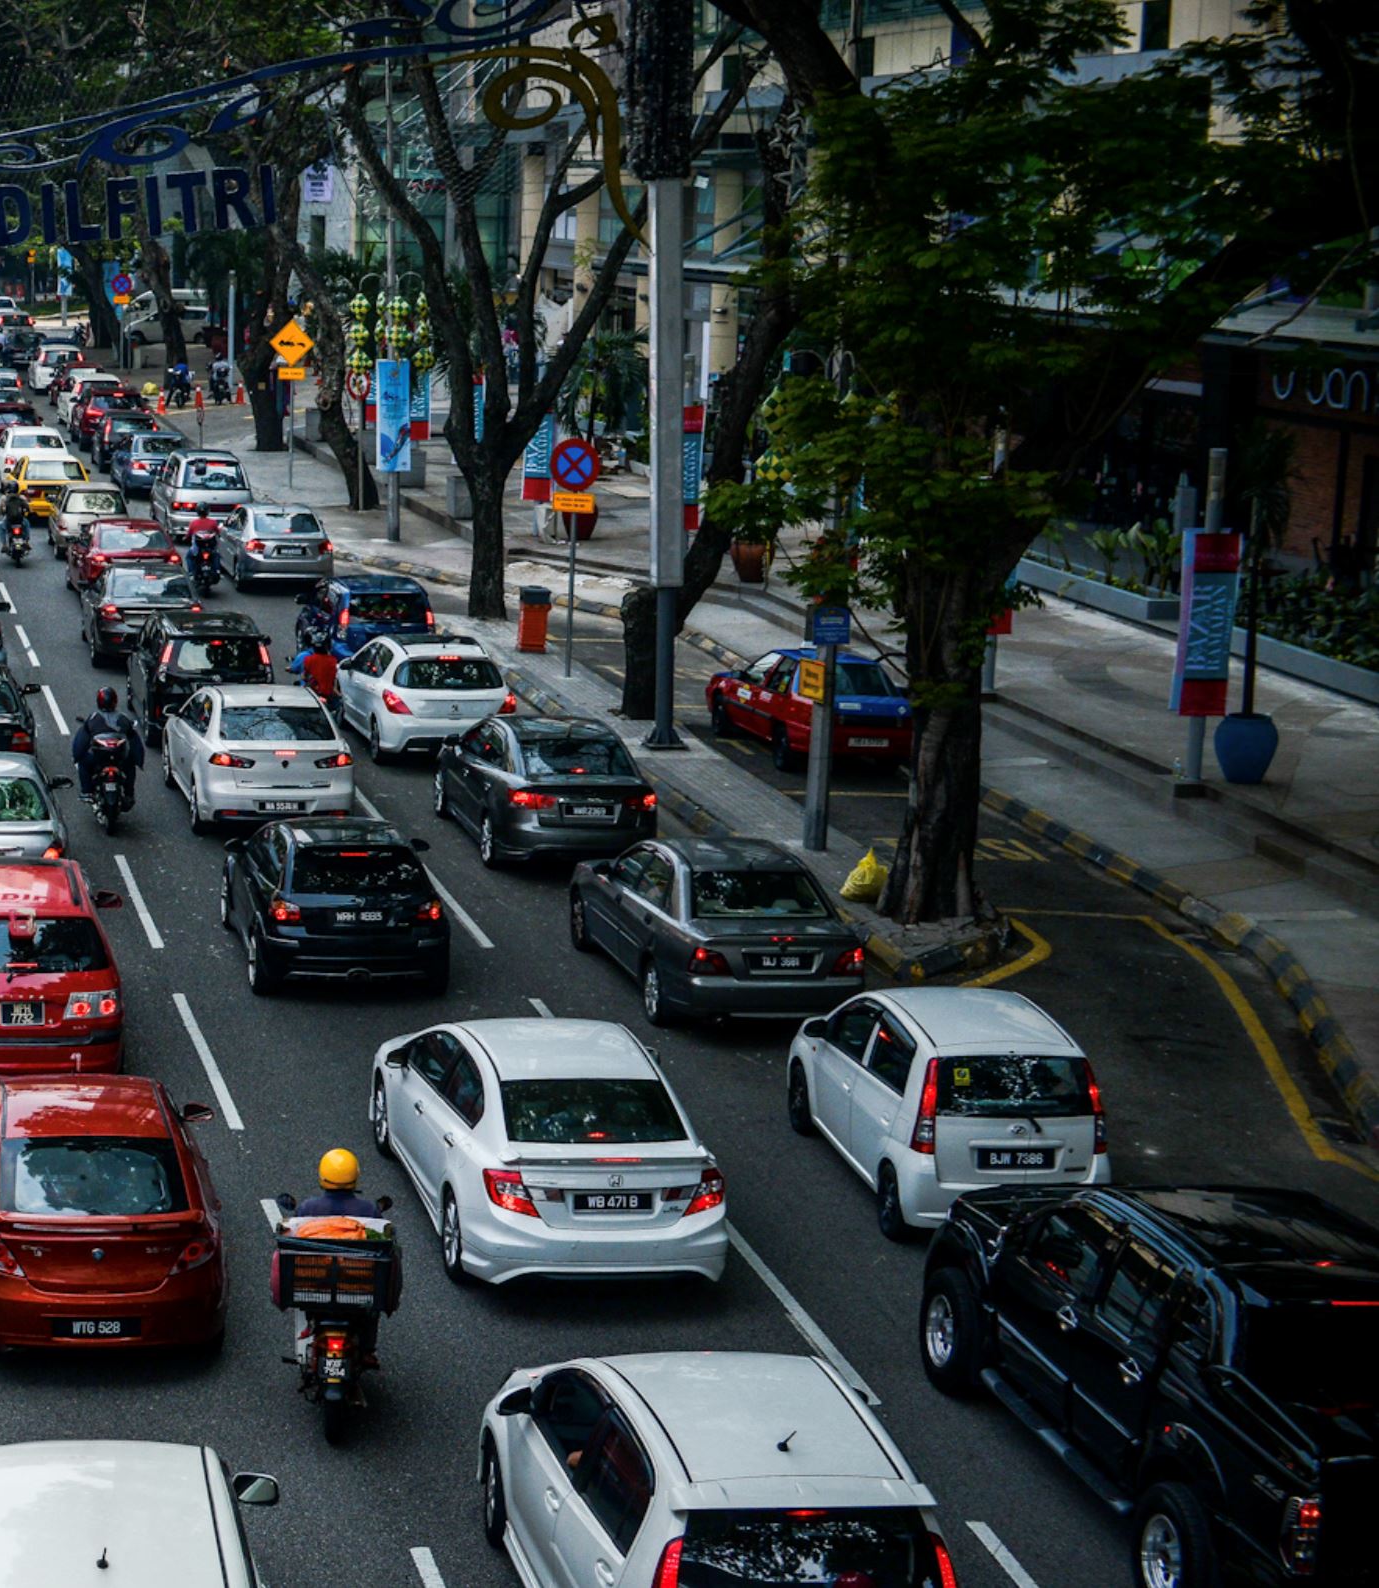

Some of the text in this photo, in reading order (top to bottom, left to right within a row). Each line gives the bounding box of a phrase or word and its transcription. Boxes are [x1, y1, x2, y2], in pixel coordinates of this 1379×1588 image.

[990, 1152, 1011, 1165] BJW
[587, 1196, 605, 1208] WB
[607, 1196, 627, 1208] 471
[72, 1321, 121, 1335] WTG 528
